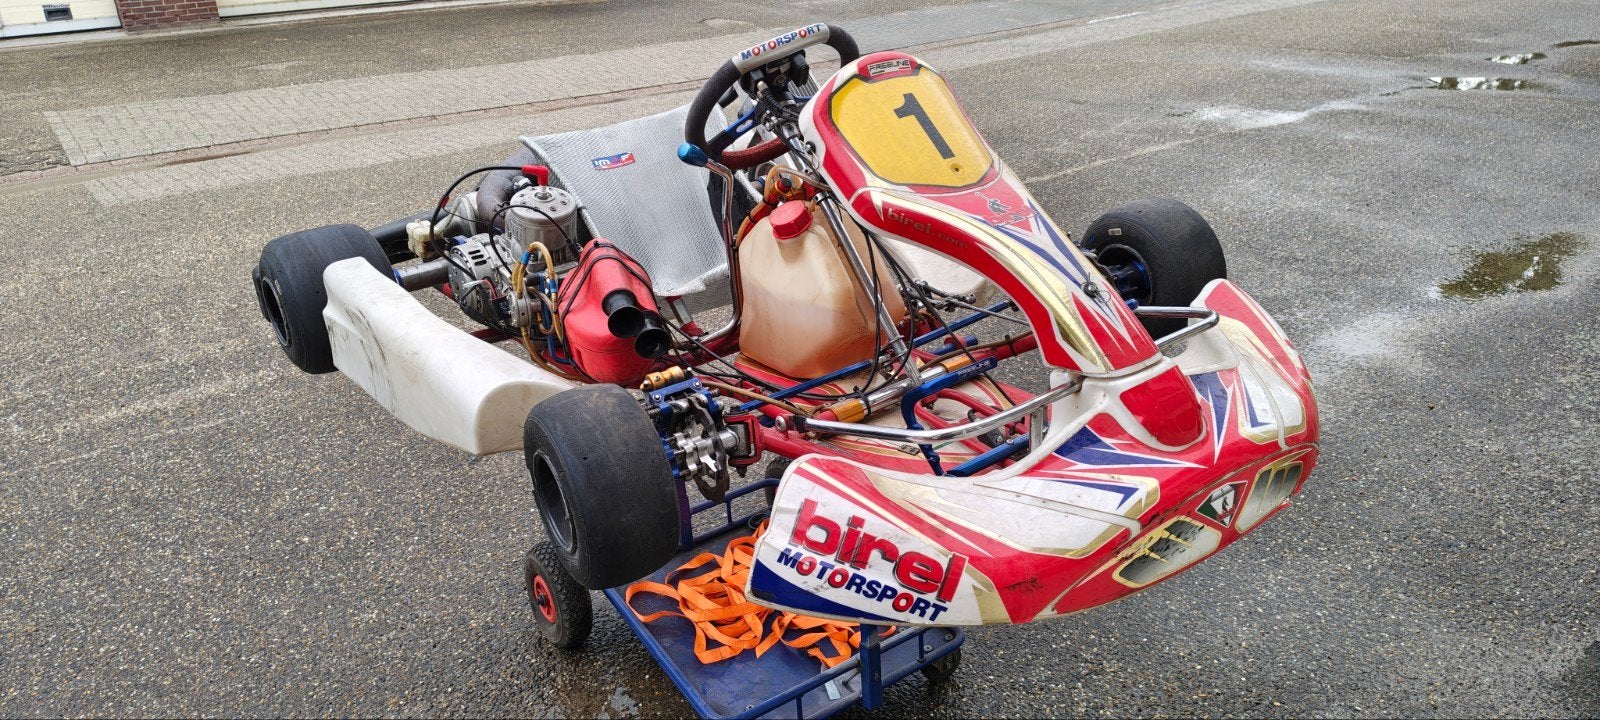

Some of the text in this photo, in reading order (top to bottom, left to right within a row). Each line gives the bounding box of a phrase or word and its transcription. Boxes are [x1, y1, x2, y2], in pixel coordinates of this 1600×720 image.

[740, 23, 823, 61] MOTORSPORT
[893, 92, 956, 160] 1
[776, 547, 948, 622] MOTORSPORT
[790, 498, 969, 602] birel
